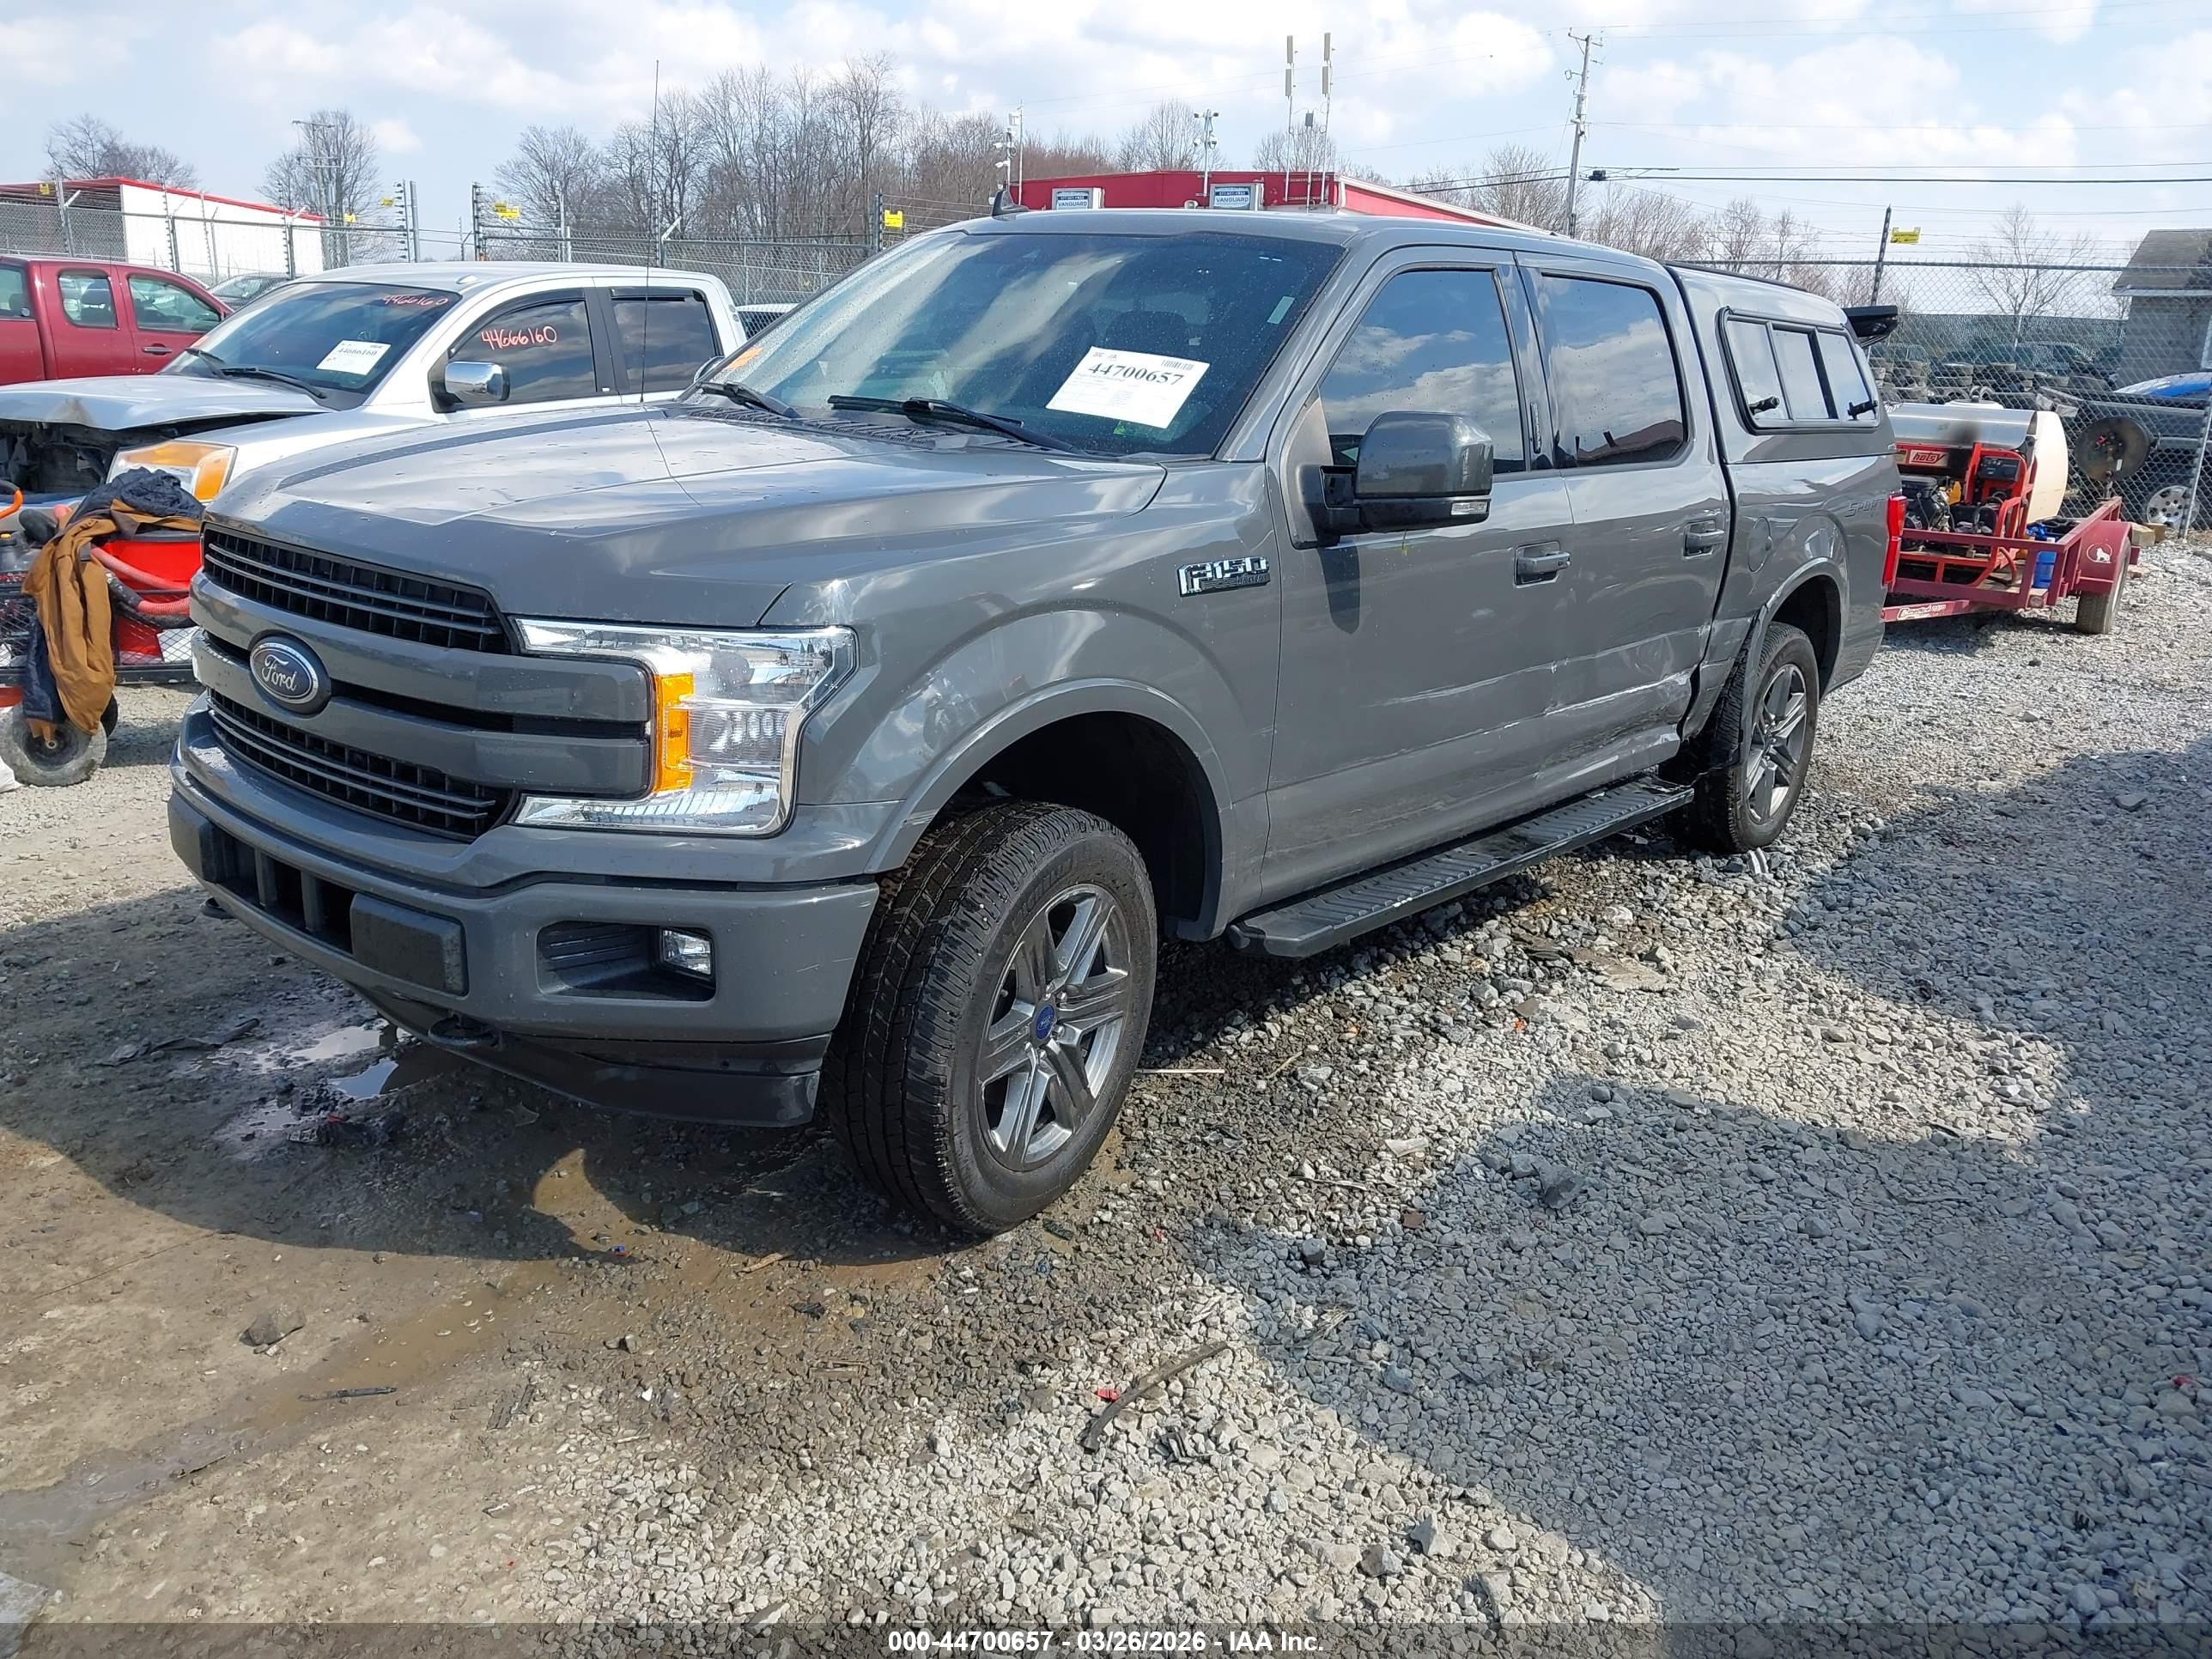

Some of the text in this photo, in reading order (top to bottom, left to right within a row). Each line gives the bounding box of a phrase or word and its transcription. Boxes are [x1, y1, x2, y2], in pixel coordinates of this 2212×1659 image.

[481, 325, 557, 350] 44666160
[1088, 362, 1185, 386] 44700657
[261, 653, 299, 692] Ford
